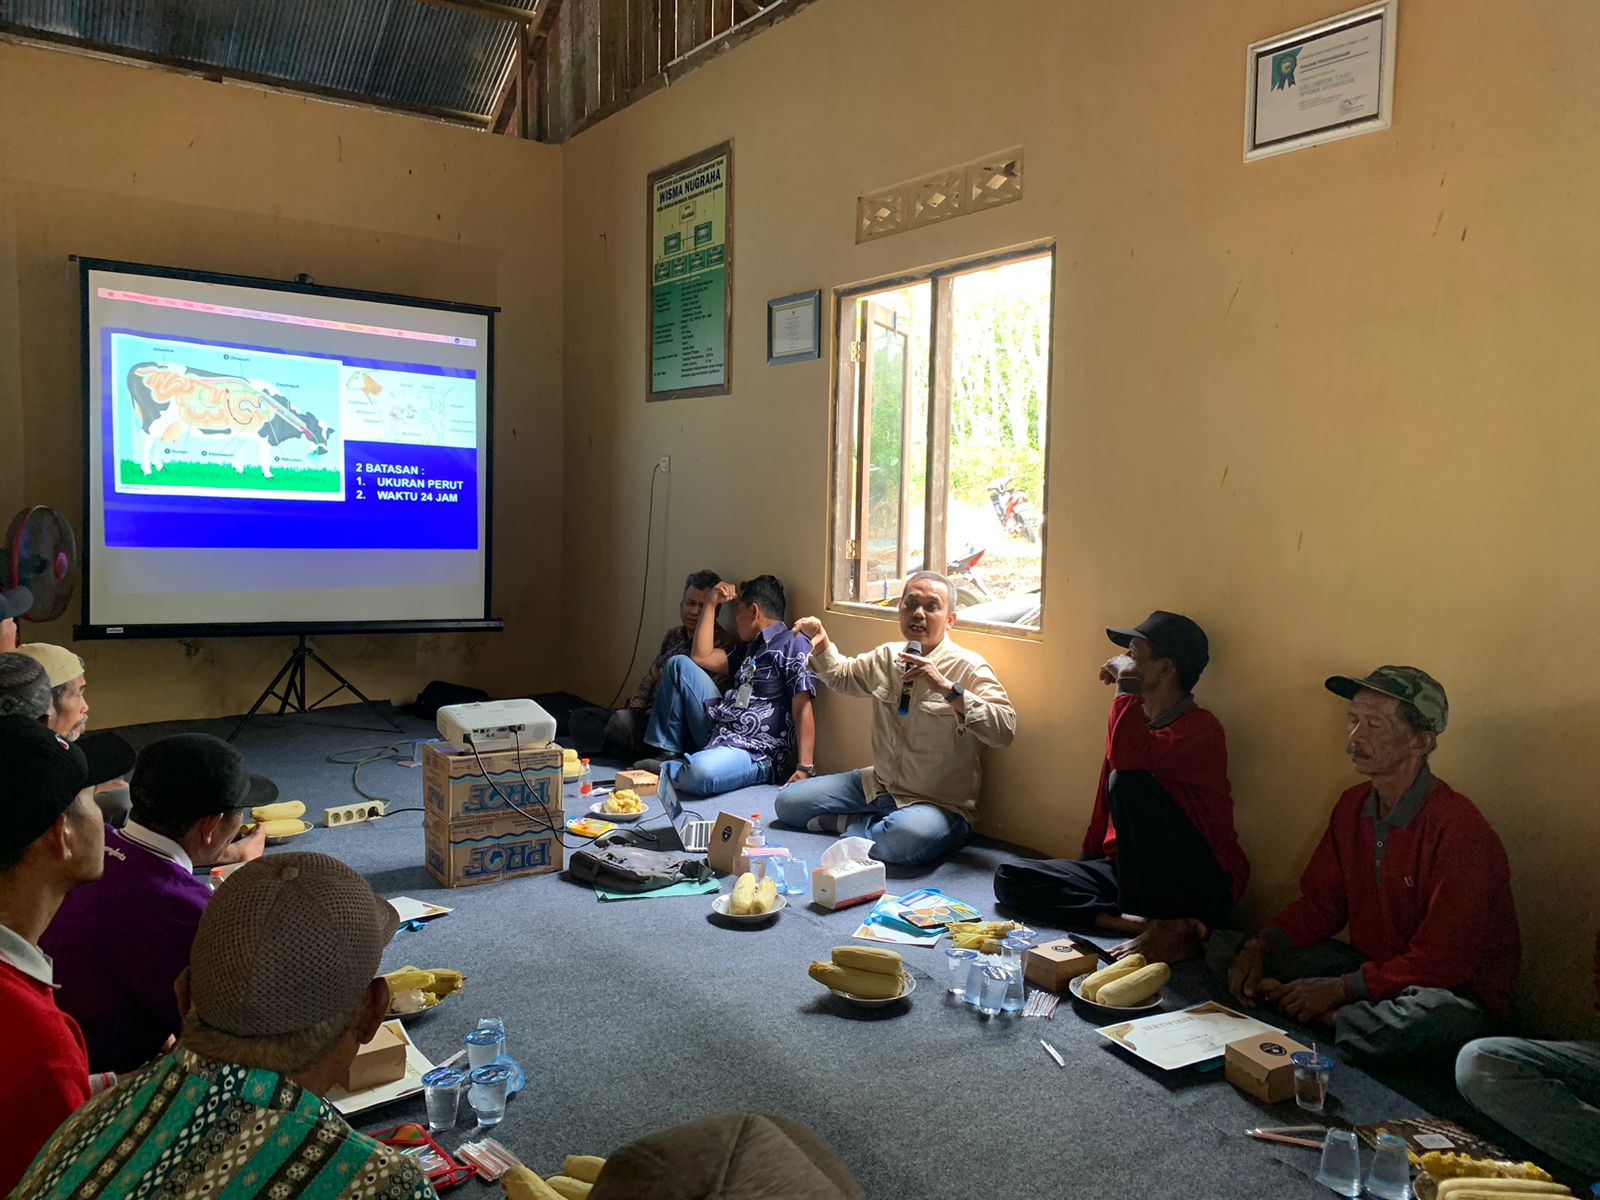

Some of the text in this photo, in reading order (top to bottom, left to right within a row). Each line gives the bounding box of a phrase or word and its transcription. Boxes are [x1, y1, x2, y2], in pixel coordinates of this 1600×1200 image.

[659, 184, 684, 205] WISMA
[684, 168, 721, 194] NUGRAHA
[355, 463, 362, 473] 2
[365, 463, 418, 475] BATASAN
[356, 476, 463, 490] 1. UKURAN PERUT
[356, 490, 458, 503] 2. WAKTU 24 JAM
